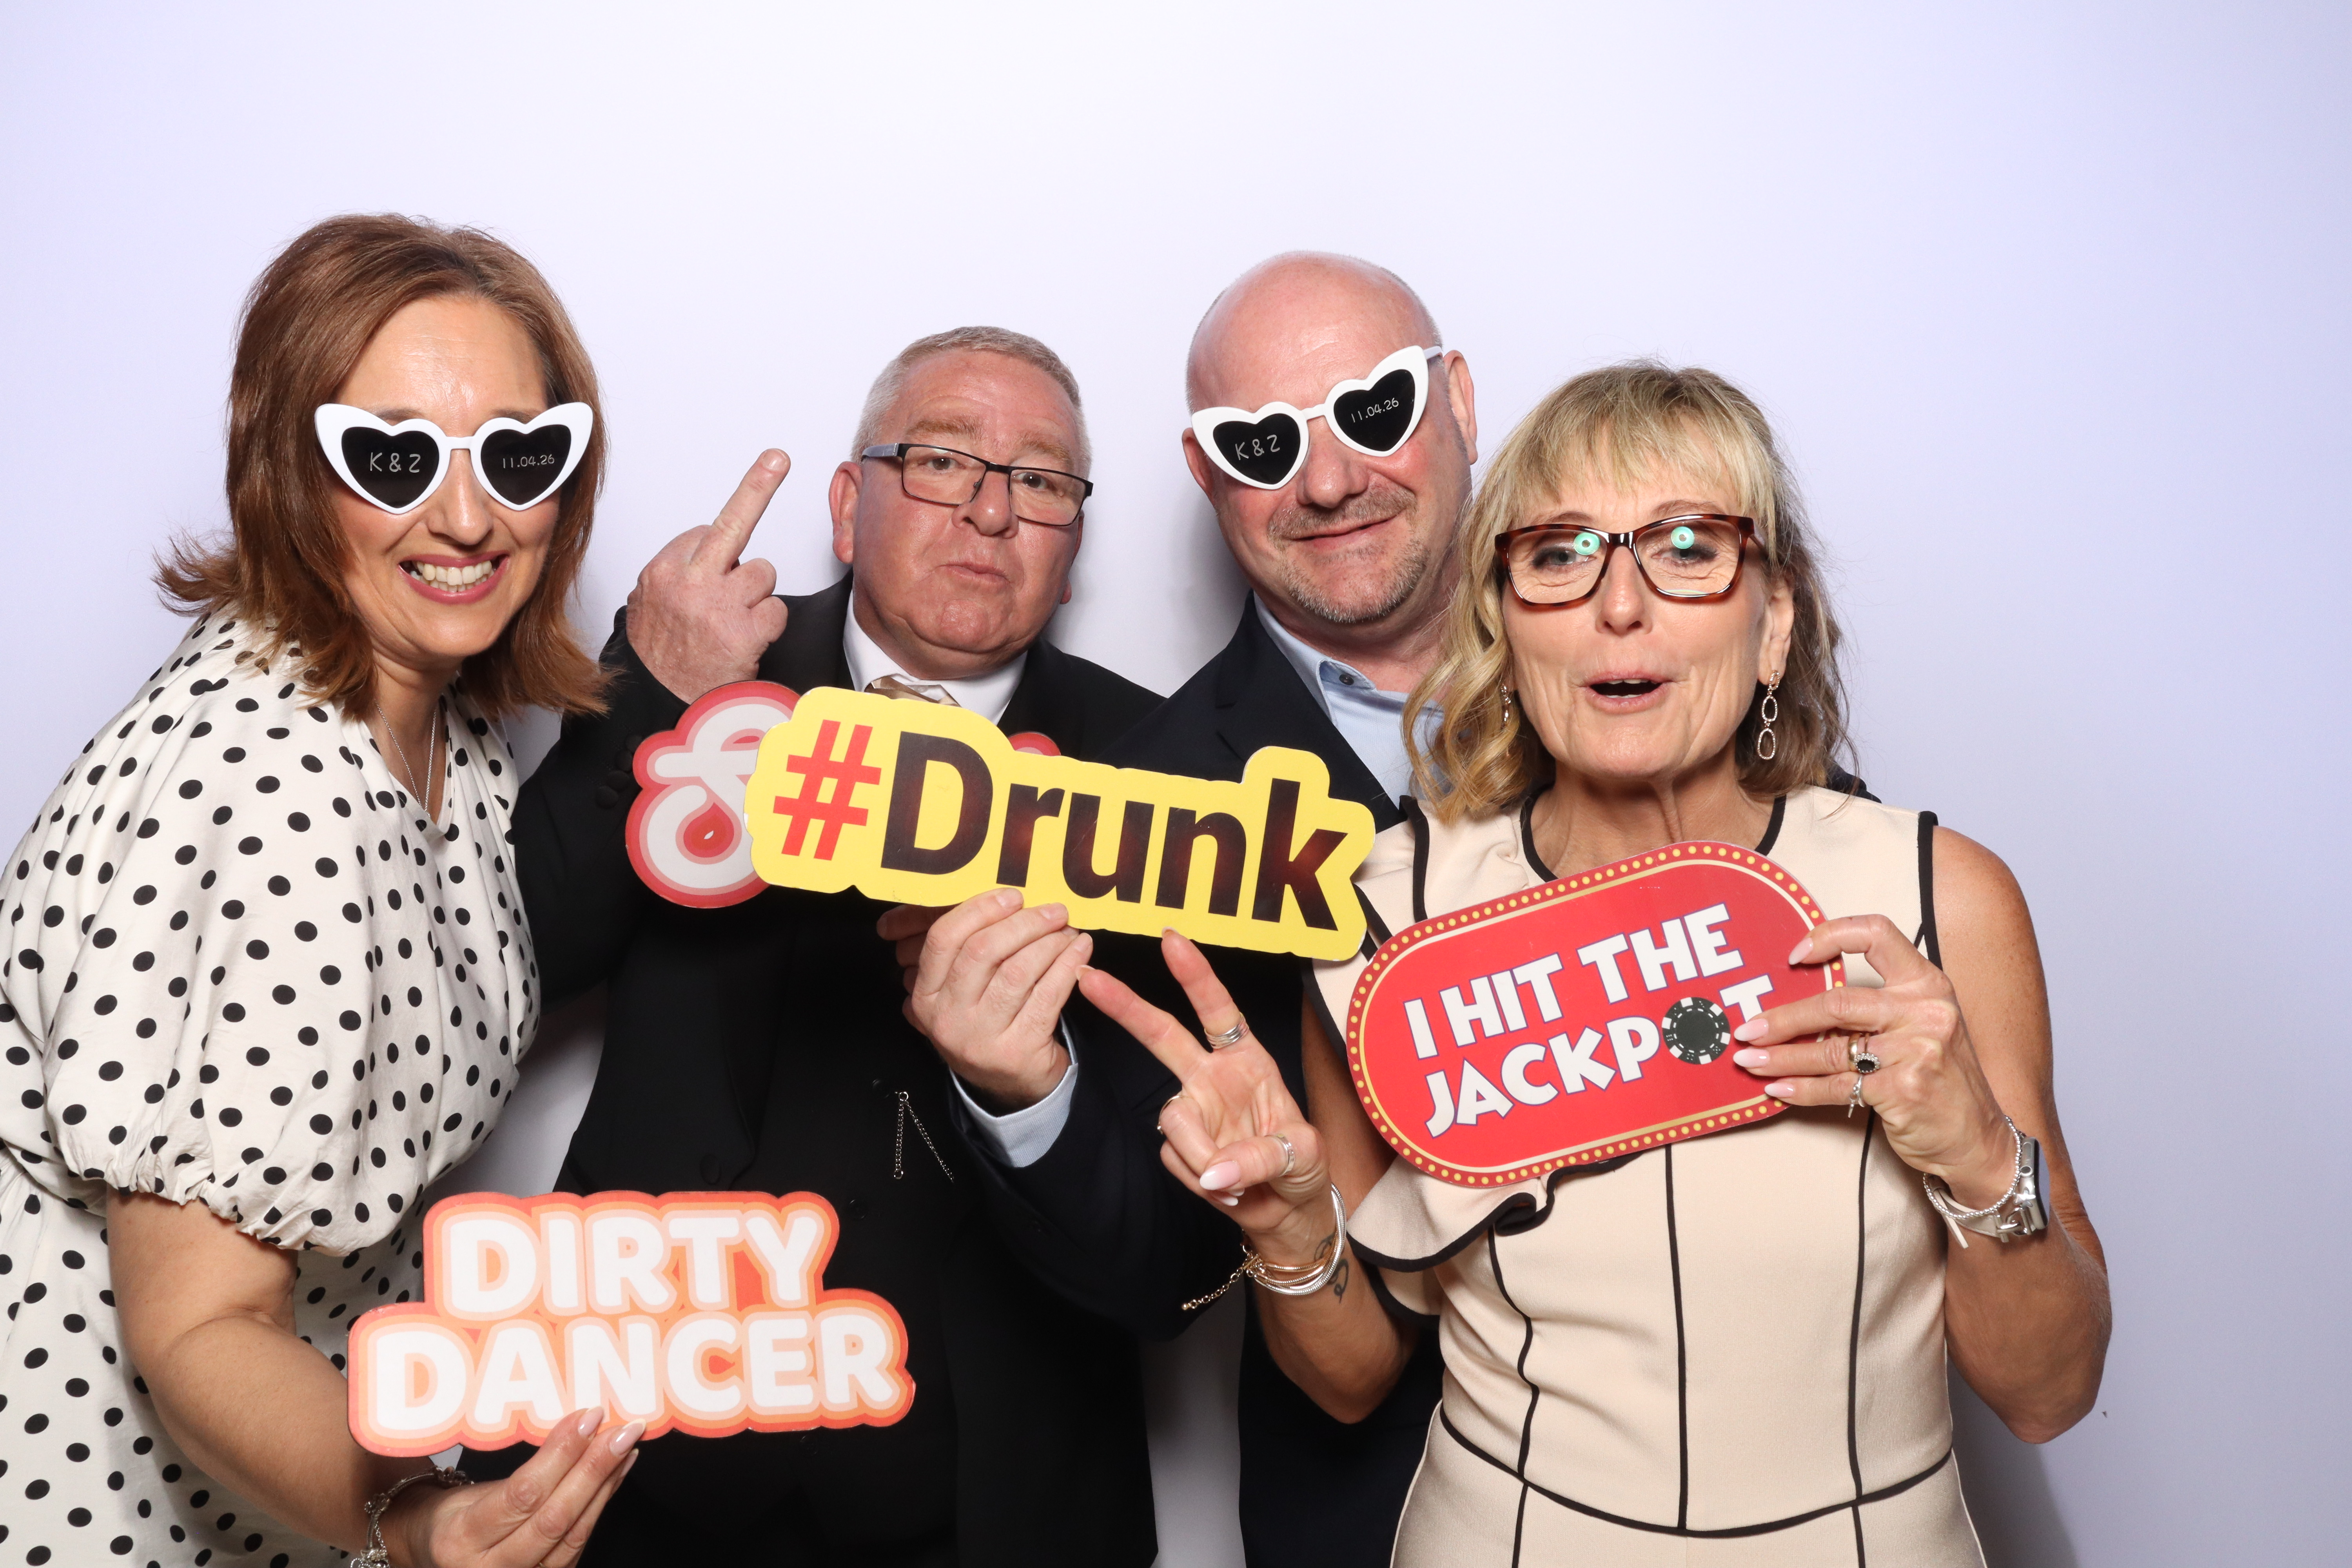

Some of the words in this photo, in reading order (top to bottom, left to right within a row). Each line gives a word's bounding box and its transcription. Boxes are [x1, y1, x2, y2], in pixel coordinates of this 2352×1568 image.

[1351, 397, 1399, 423] 11.04.26
[369, 452, 383, 472] K
[388, 452, 402, 473] &
[503, 454, 555, 469] 11.04.26
[1234, 441, 1250, 461] K
[1252, 438, 1265, 457] &
[773, 720, 1348, 931] #Drunk
[1404, 998, 1438, 1059] I
[1439, 953, 1564, 1047] HIT
[1577, 903, 1744, 1004] THE
[449, 1216, 818, 1314] DIRTY
[375, 1314, 893, 1432] DANCER
